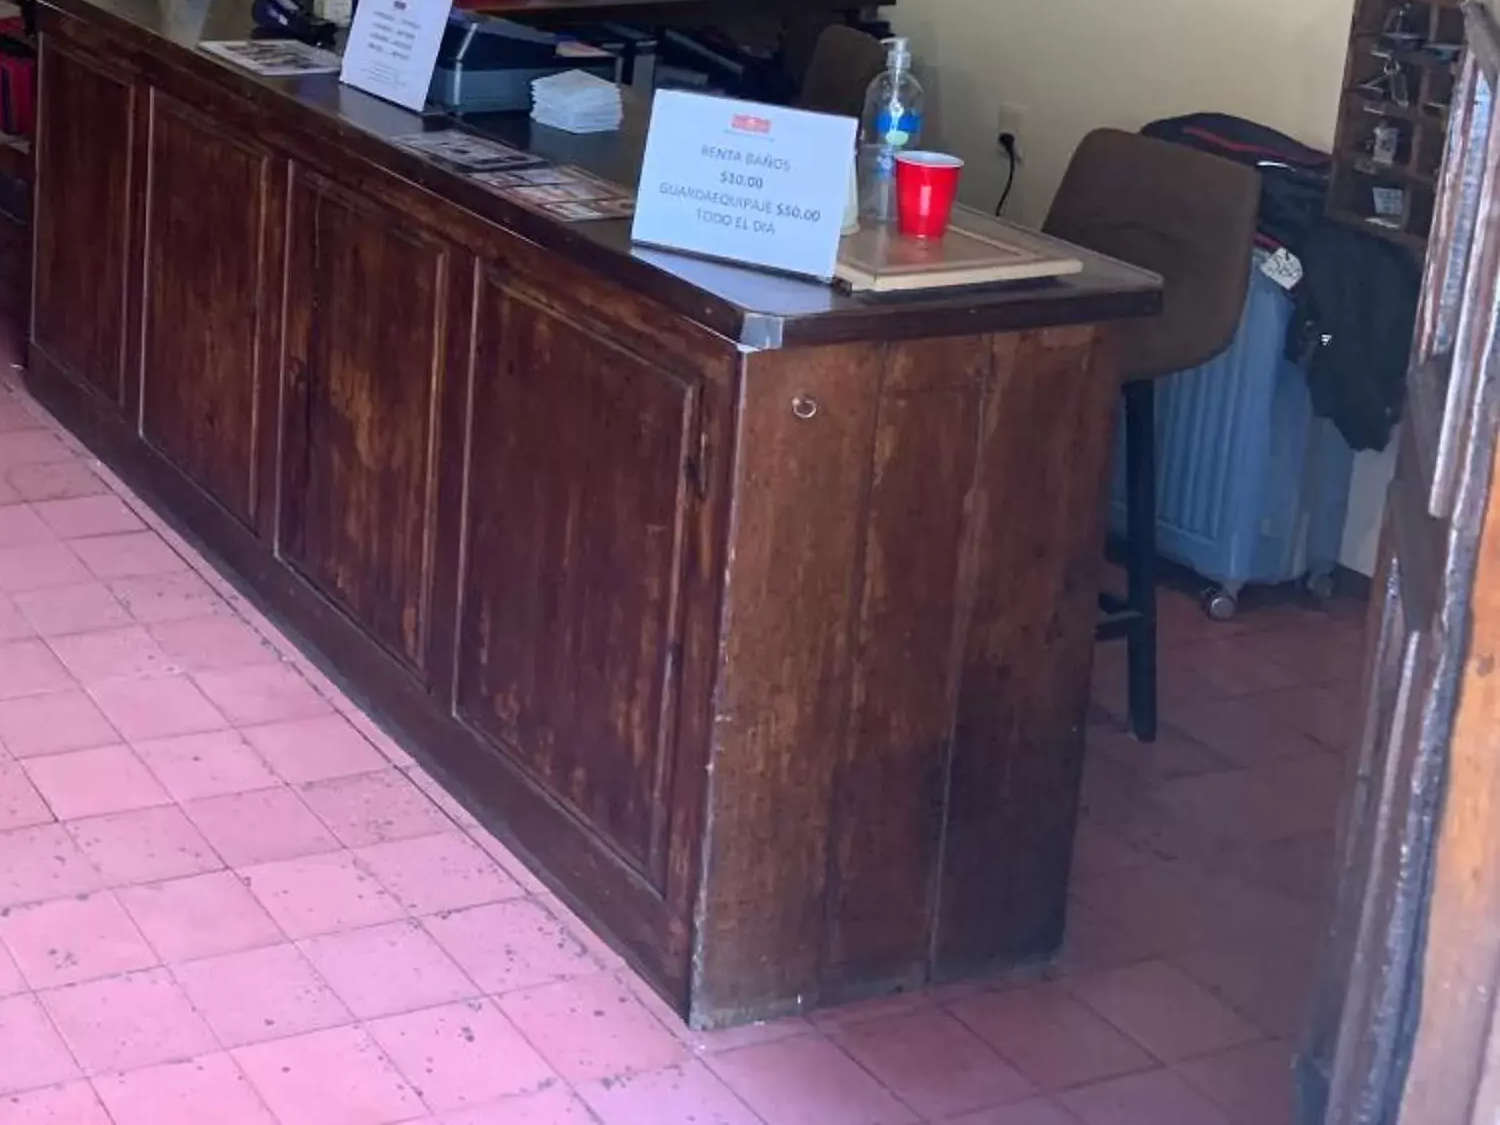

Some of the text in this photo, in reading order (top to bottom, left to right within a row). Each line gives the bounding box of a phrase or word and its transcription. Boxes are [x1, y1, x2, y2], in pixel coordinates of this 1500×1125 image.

[701, 144, 791, 172] RENTA BAÑOS
[720, 171, 764, 190] $10.00
[695, 208, 732, 226] TODO
[735, 215, 748, 230] EL
